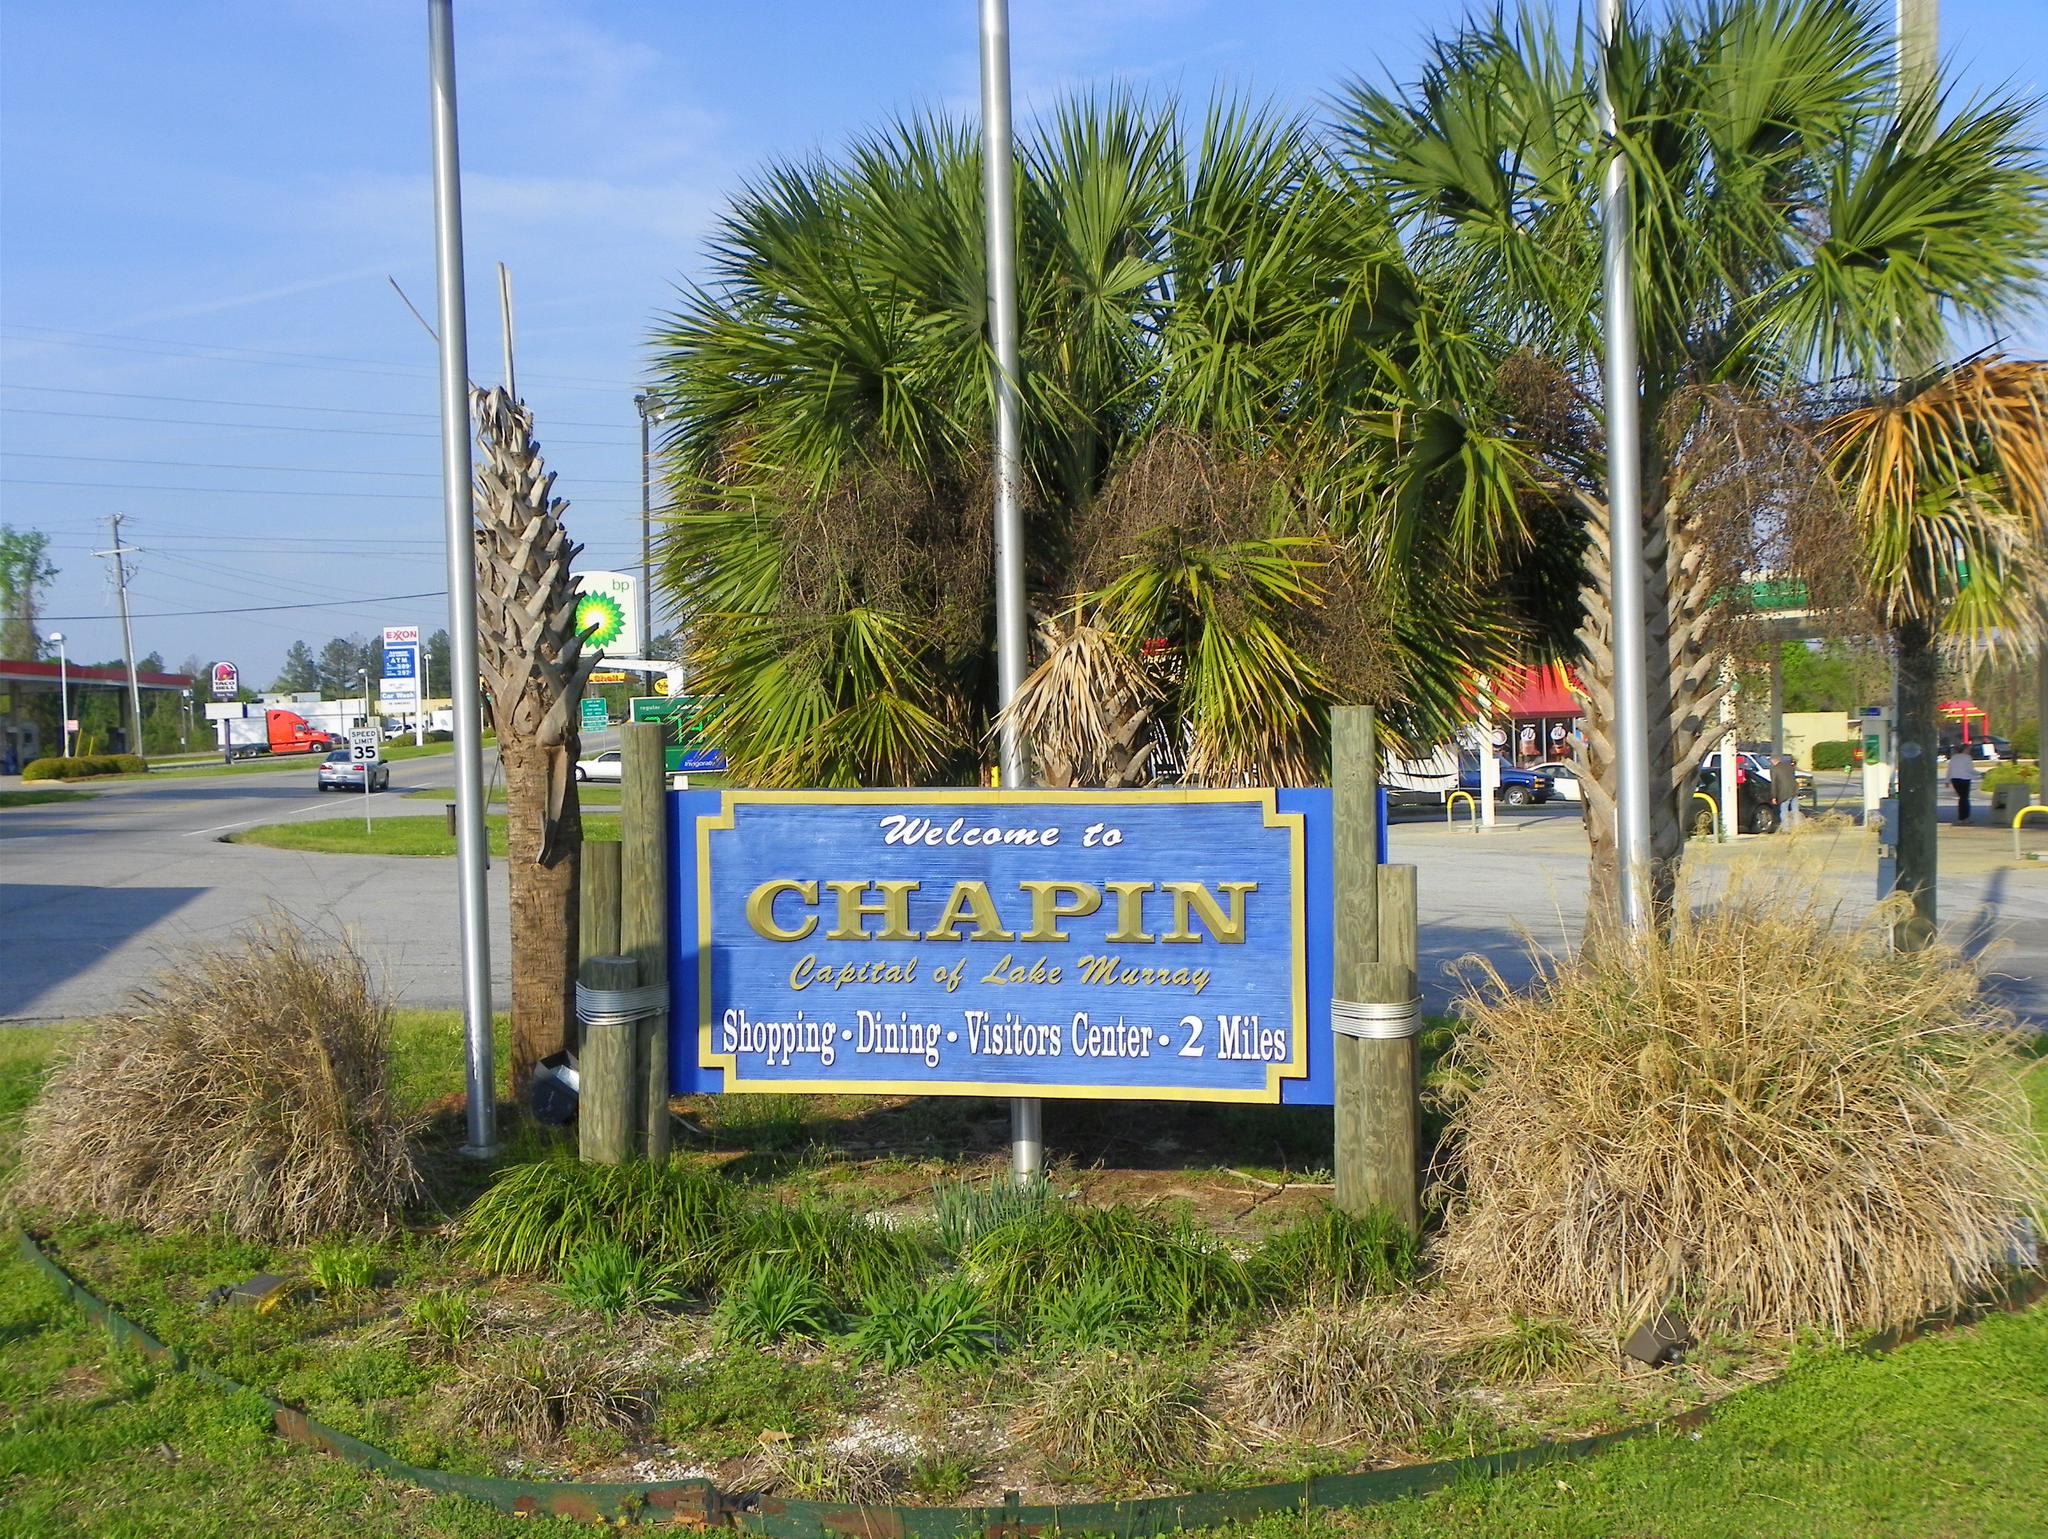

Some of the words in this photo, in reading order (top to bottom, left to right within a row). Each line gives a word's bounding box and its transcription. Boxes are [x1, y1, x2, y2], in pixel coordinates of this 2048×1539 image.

[612, 579, 630, 592] bp
[386, 630, 417, 641] EXXON
[352, 730, 376, 738] SPEED
[354, 746, 376, 759] 35
[880, 814, 1060, 846] Welcome
[1082, 822, 1124, 847] to
[746, 879, 1259, 944] CHAPIN
[789, 954, 919, 991] Capital
[933, 957, 967, 993] of
[980, 954, 1063, 986] Lake
[1077, 955, 1211, 995] Murray
[722, 1009, 837, 1066] Shopping
[856, 1010, 941, 1068] Dining
[964, 1010, 1062, 1057] Visitors
[1071, 1011, 1153, 1058] Center
[1177, 1015, 1206, 1058] 2
[1217, 1014, 1287, 1062] Miles
